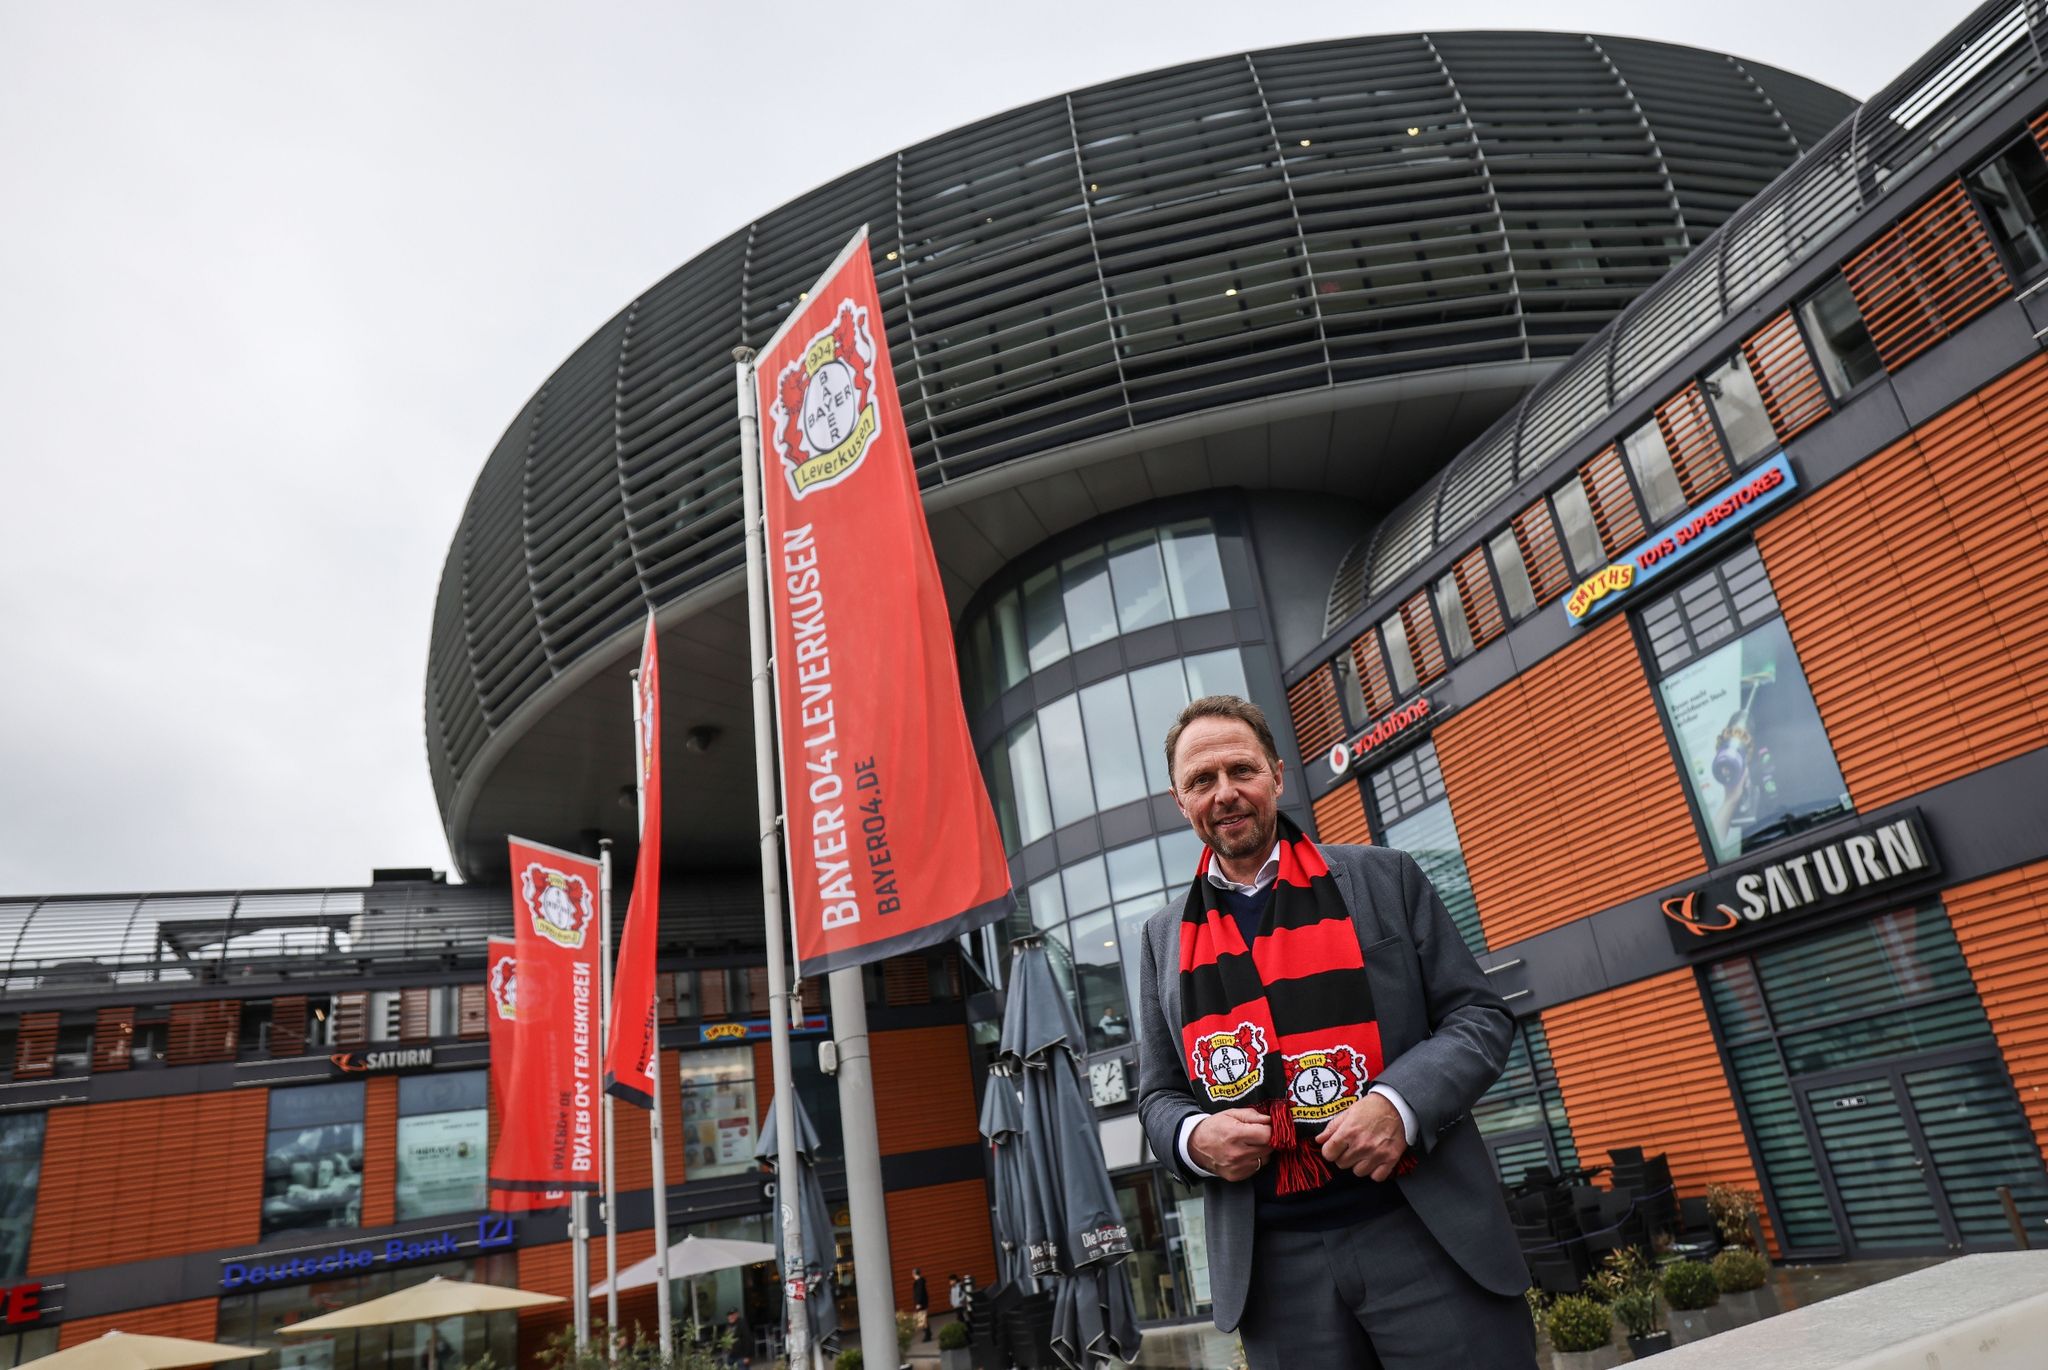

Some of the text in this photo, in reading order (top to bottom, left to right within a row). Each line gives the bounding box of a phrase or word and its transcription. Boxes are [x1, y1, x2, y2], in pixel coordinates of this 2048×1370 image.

[807, 384, 852, 428] BAYER
[818, 371, 842, 443] BAYER
[800, 417, 871, 483] Leverkusen
[1568, 467, 1783, 616] SMYTHS TOYS SUPERSTORES
[783, 523, 861, 931] BAYER 04 LEVERKUSEN
[1353, 698, 1430, 756] vodafone
[854, 755, 901, 916] BAYER04.DE
[1736, 819, 1927, 921] SATURN
[366, 1048, 433, 1070] SATURN
[1298, 1079, 1338, 1093] BAYER
[223, 1232, 459, 1288] Deutsche Bank
[1081, 1232, 1097, 1248] Die
